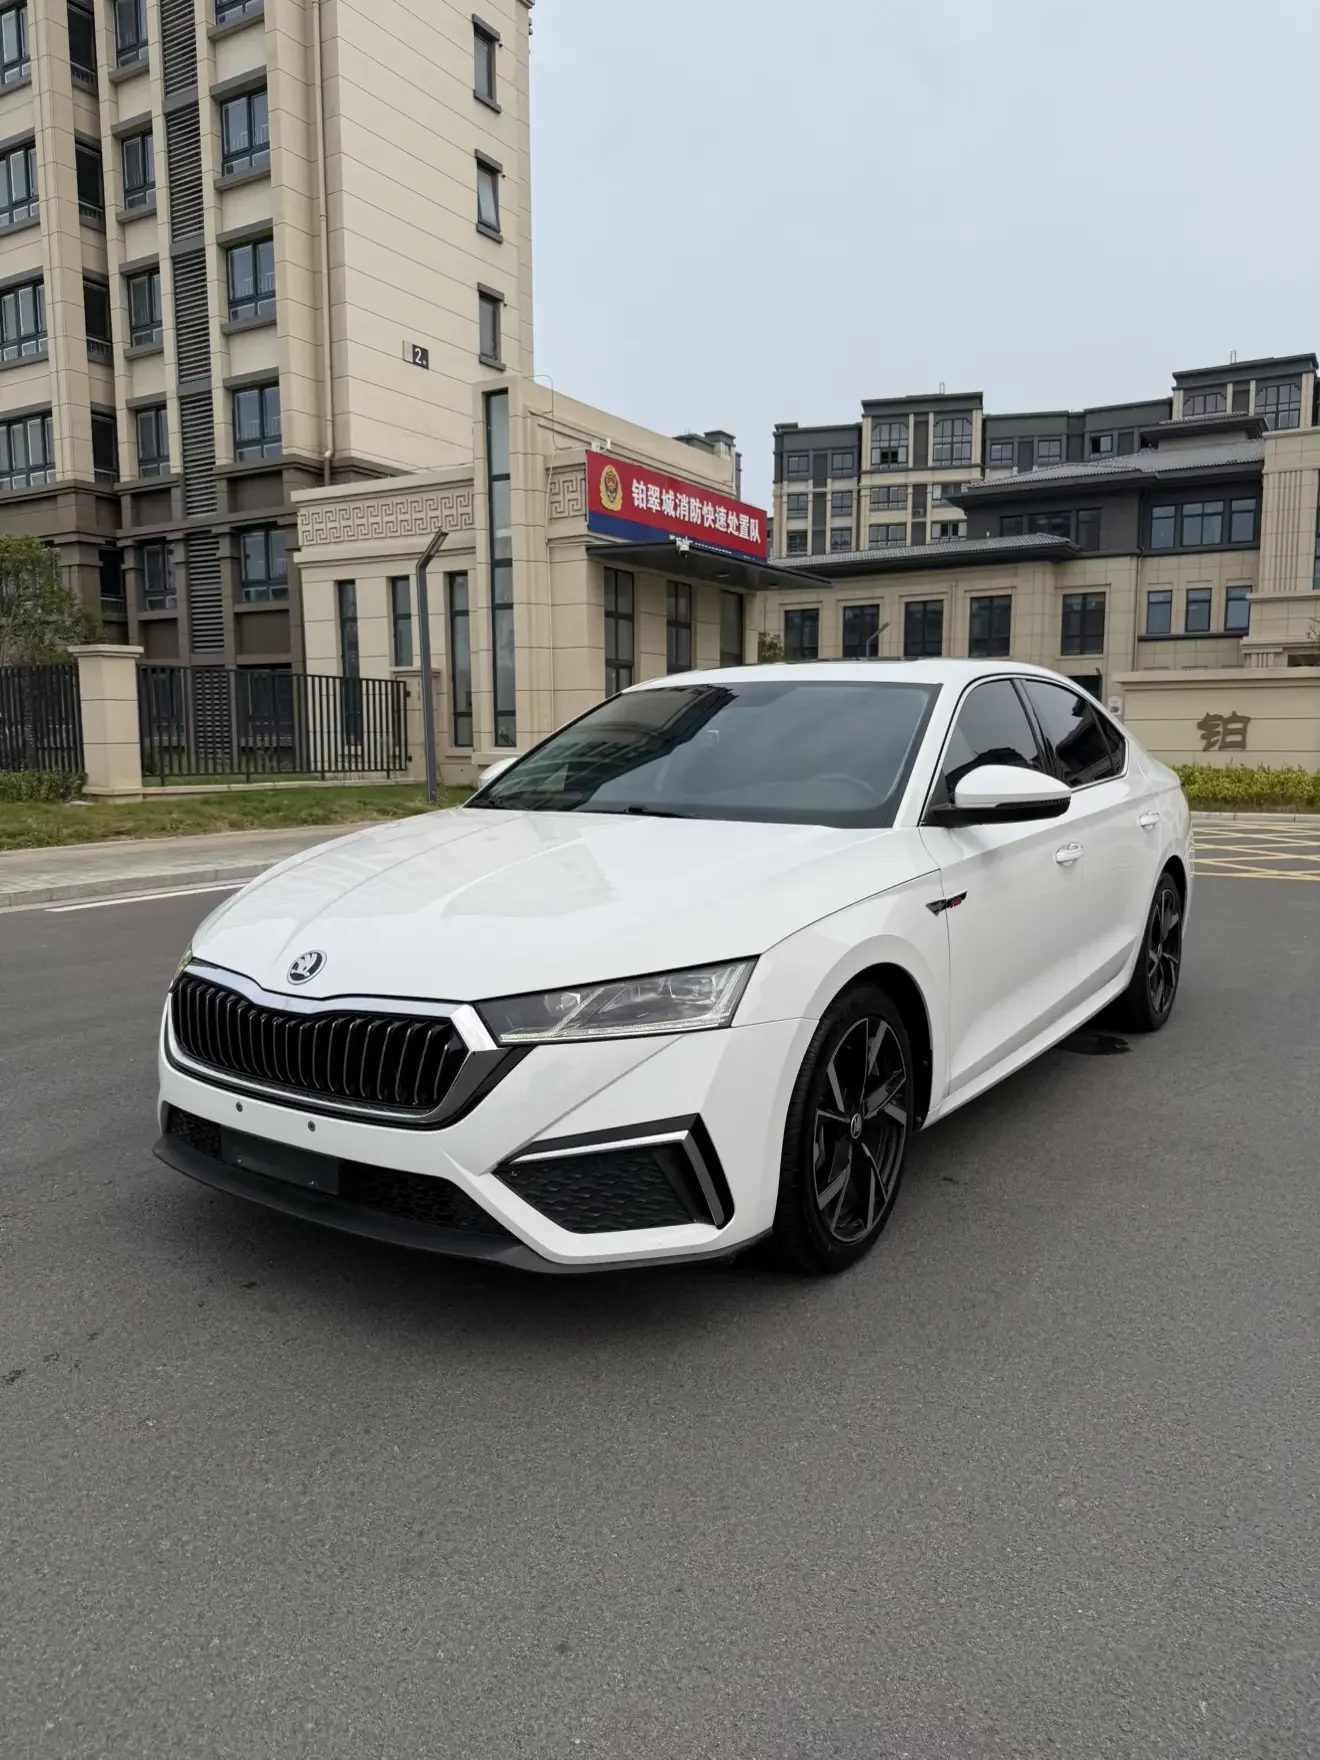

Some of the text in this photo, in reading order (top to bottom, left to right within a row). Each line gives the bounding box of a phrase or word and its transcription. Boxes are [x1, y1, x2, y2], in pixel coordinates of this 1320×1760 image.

[414, 347, 422, 364] 2
[631, 478, 761, 544] 铂翠城消防快速处置队
[1196, 710, 1252, 752] 铂
